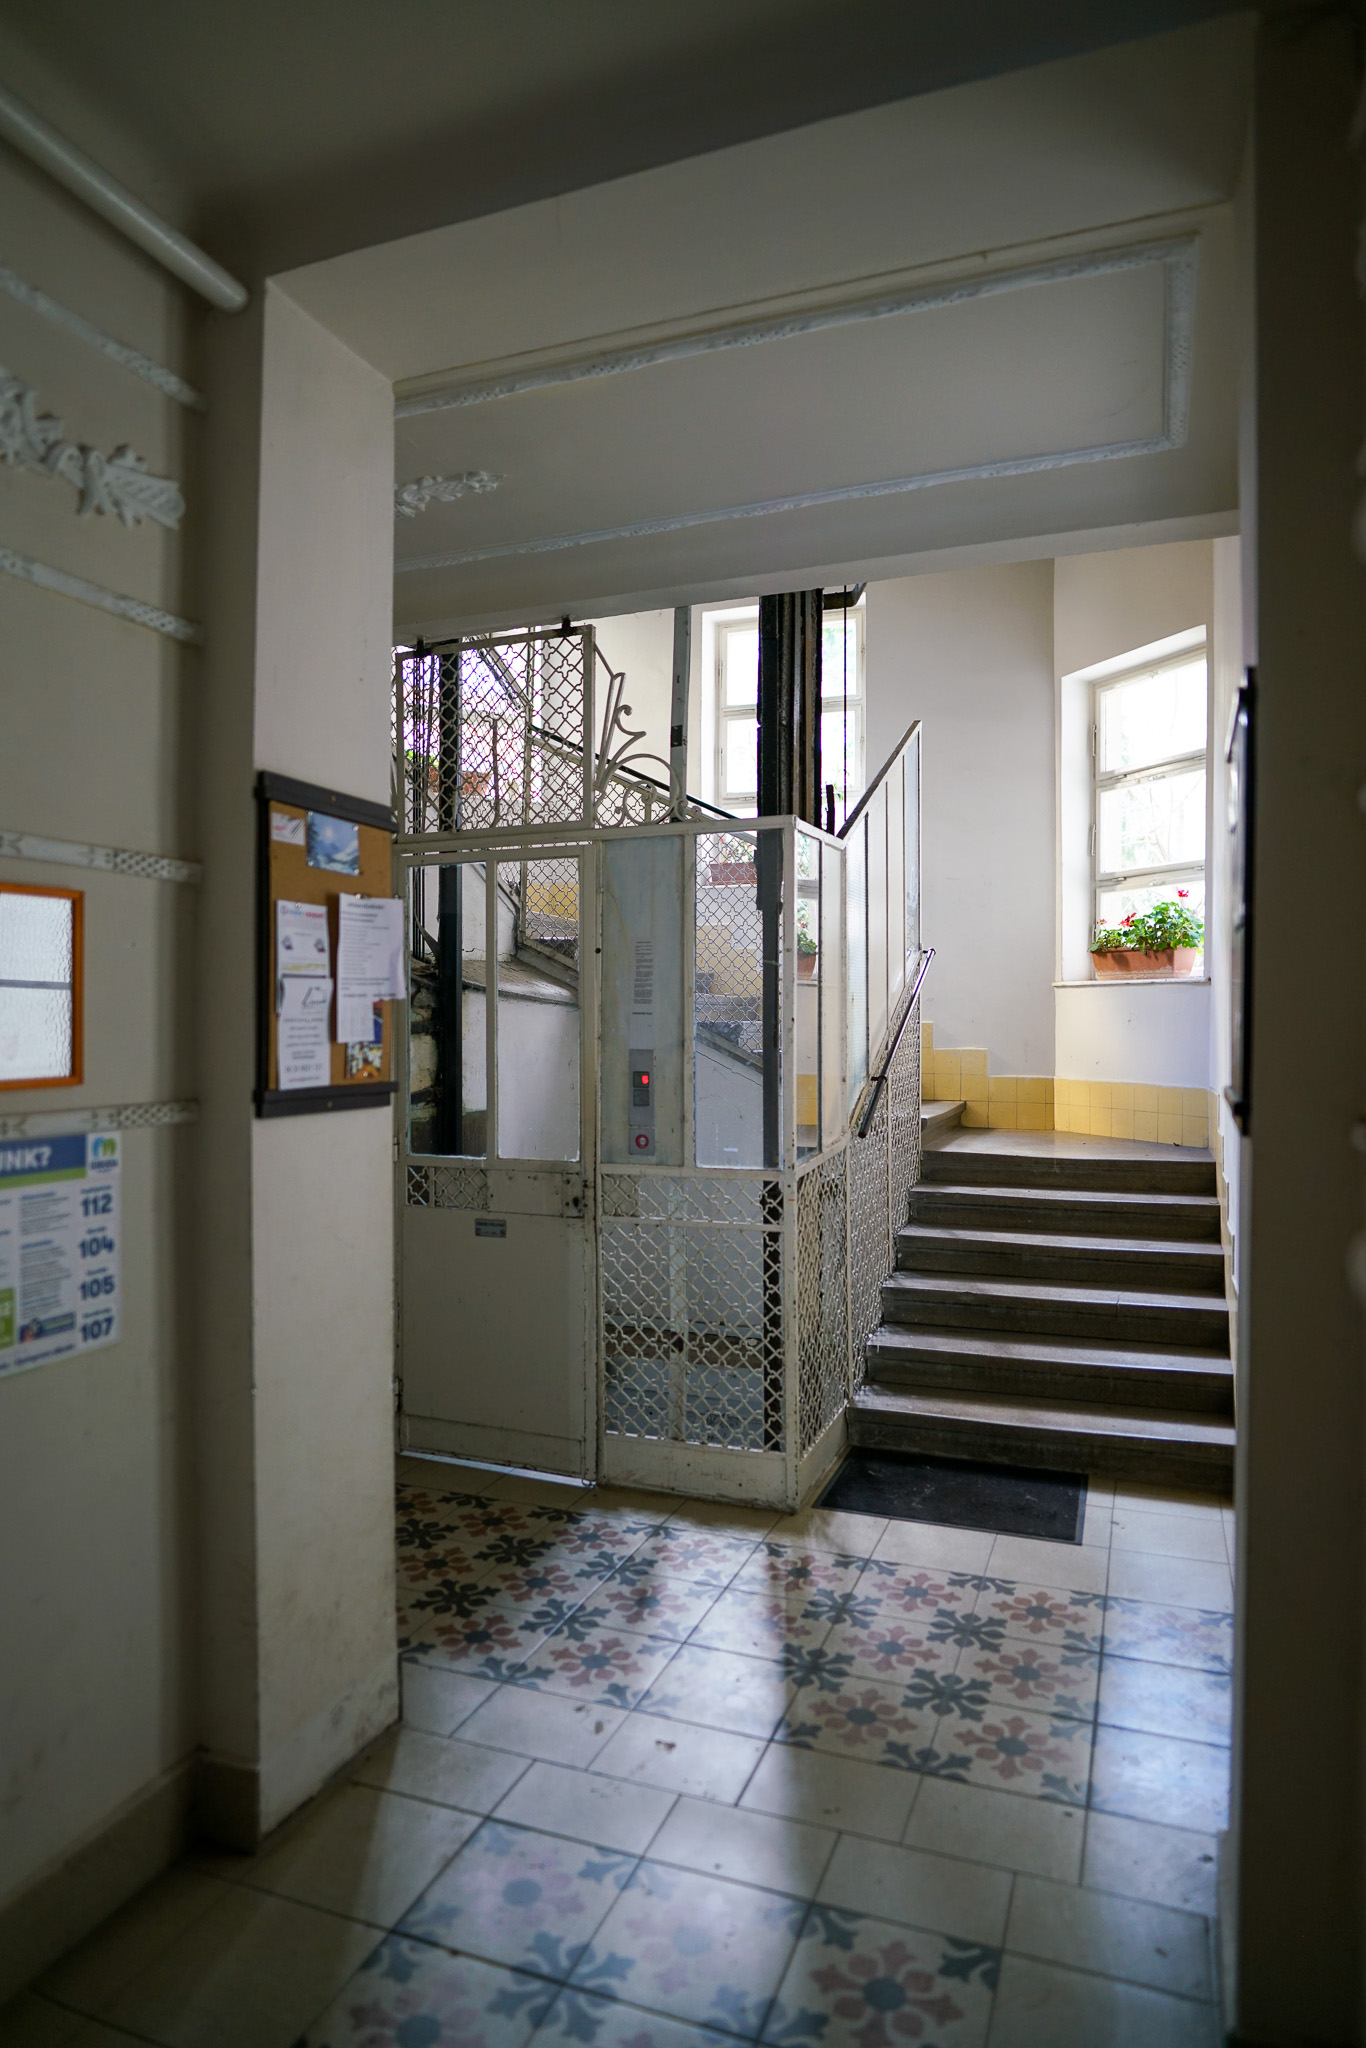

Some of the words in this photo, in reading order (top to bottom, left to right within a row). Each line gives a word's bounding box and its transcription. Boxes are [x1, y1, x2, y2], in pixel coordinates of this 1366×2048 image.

[81, 1194, 112, 1216] 112
[79, 1236, 114, 1258] 104
[79, 1275, 114, 1299] 105
[80, 1316, 113, 1341] 107
